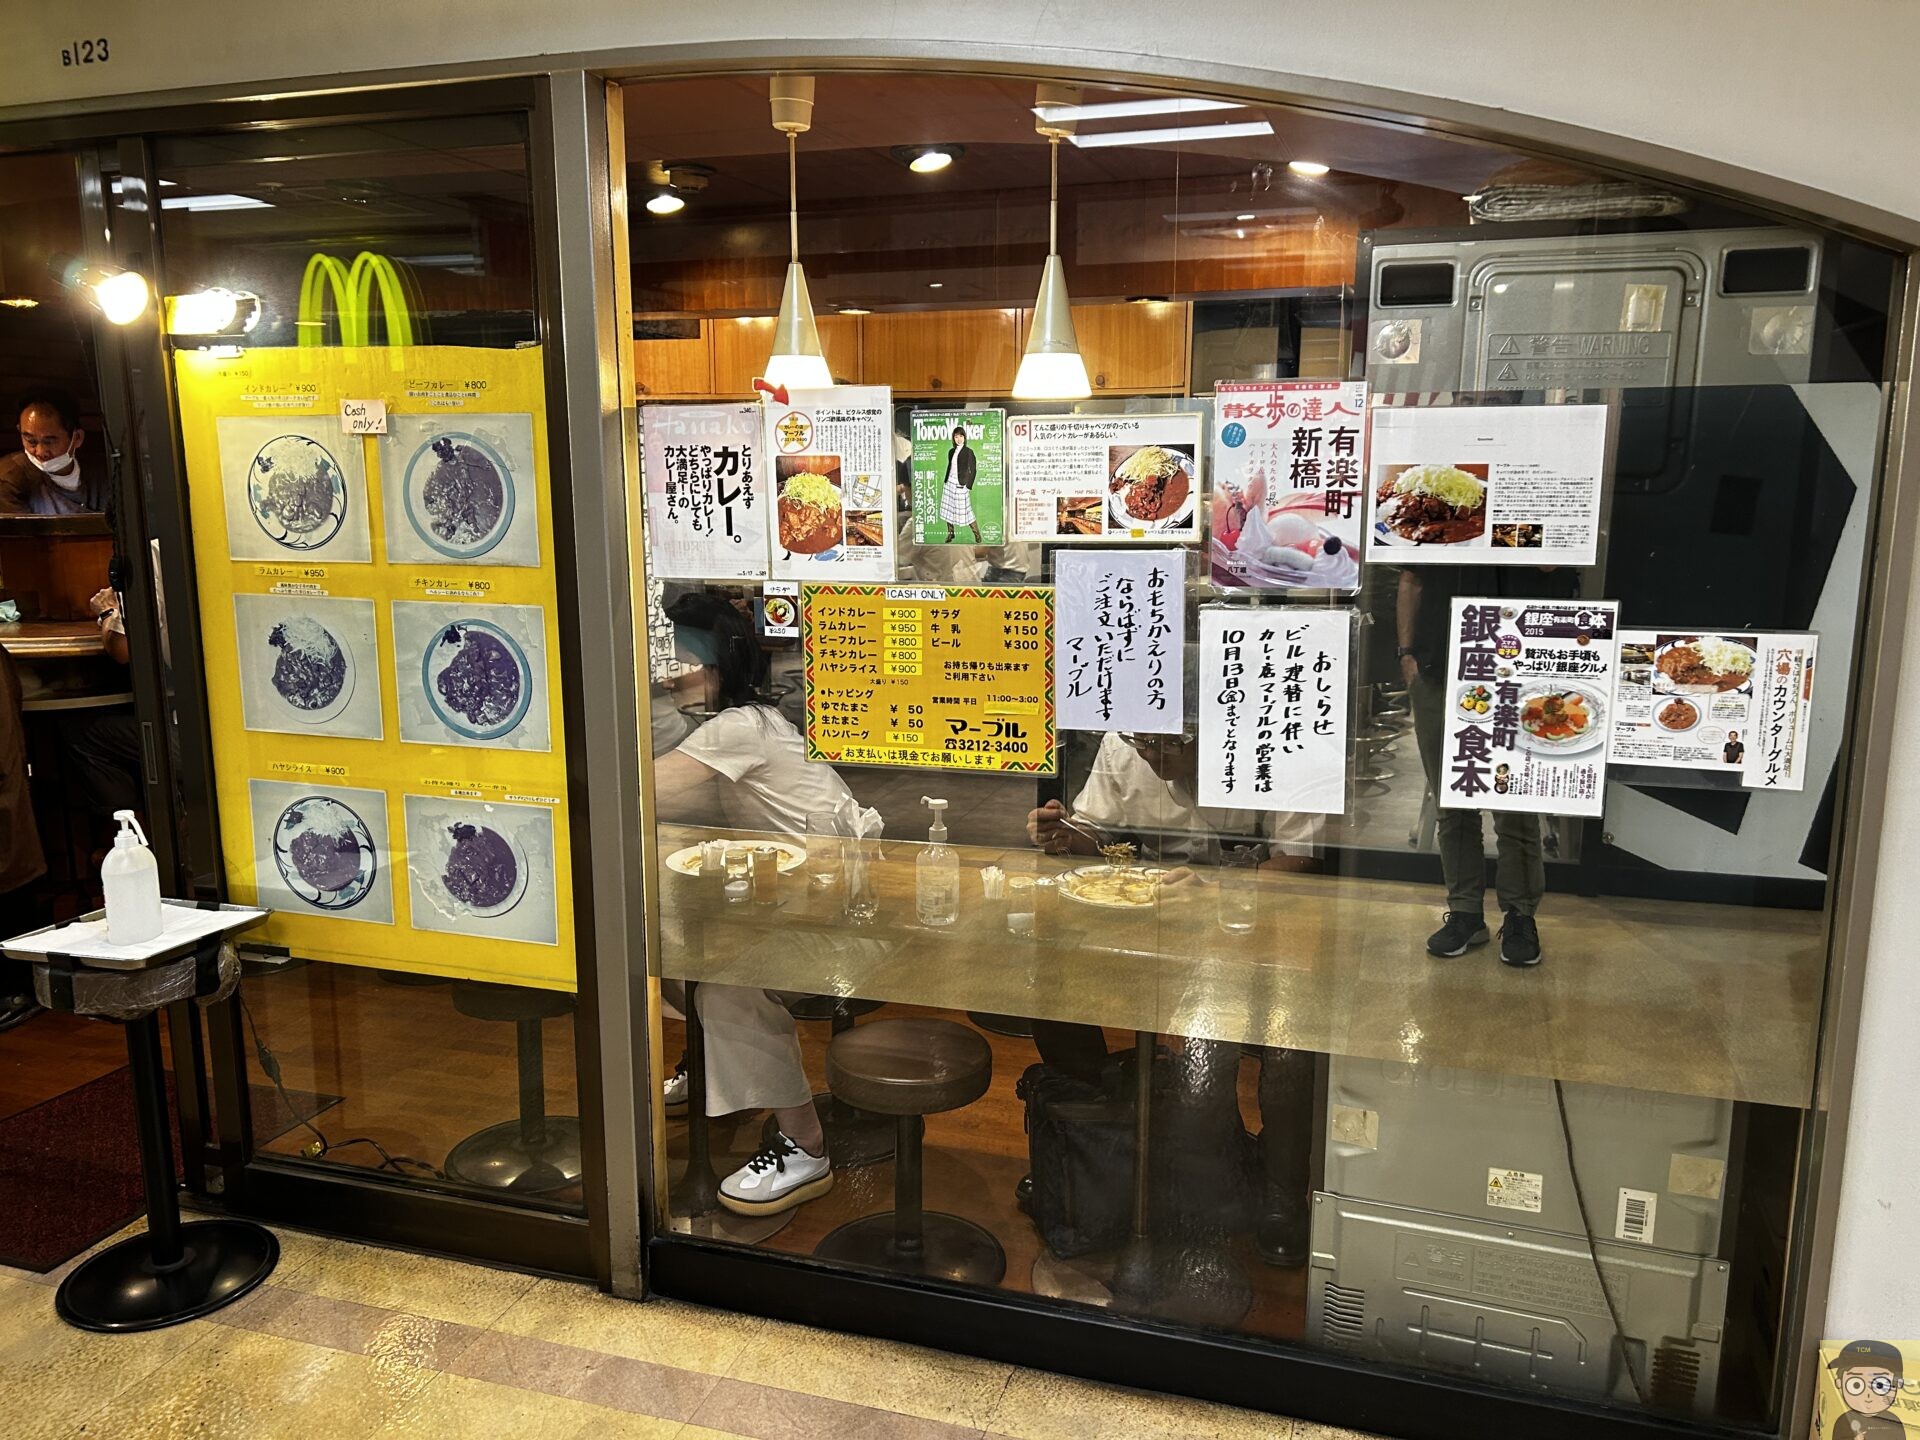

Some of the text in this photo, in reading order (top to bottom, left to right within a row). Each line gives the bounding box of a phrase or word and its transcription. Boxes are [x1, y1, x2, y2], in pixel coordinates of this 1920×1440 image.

[1578, 336, 1649, 355] WARNING
[409, 381, 487, 389] ビーフカレー ¥800
[344, 404, 366, 416] Cash
[1222, 391, 1360, 429] 散歩の達人
[1355, 399, 1364, 407] 12
[1014, 424, 1027, 436] 05
[1034, 422, 1140, 432] てんこ盛りの千切りキャベツがのっている
[1034, 431, 1118, 440] 人気のインドカレーがあるらしい。
[1290, 426, 1322, 489] 新橋
[676, 445, 689, 508] 大満足!の
[741, 444, 754, 509] とりあえず
[1325, 426, 1360, 519] 有楽町
[664, 445, 678, 524] カレー屋さん。
[689, 445, 702, 531] どちらにしても
[700, 445, 713, 537] やっぱりカレー!
[713, 446, 741, 543] カレー。
[926, 470, 935, 524] 新しい丸の内
[259, 567, 325, 578] ラムカレー ¥950
[415, 579, 491, 590] チキンカレー ¥800
[921, 591, 945, 599] ONLY
[818, 607, 917, 618] インドカレー ¥900
[930, 609, 1039, 621] サラダ ¥250
[818, 621, 917, 632] ラムカレー ¥950
[1116, 578, 1141, 662] ならばずに
[1004, 626, 1038, 635] ¥150
[819, 635, 917, 646] ビーフカレー ¥800
[931, 638, 1039, 650] ビール ¥300
[1147, 567, 1171, 710] おもちかえりの方
[1458, 604, 1502, 681] 銀座
[1094, 573, 1114, 721] ご注文いただけます
[820, 649, 917, 660] チキンカレー ¥800
[1525, 648, 1600, 662] 贅沢もお手頃も
[820, 663, 917, 674] ハヤシライス ¥900
[944, 661, 1029, 672] お持ち帰りも出来ます
[1066, 637, 1092, 698] マーブル
[1513, 660, 1608, 674] やっぱり!銀座グルメ
[944, 672, 995, 682] ご利用下さい
[1280, 624, 1310, 753] ビル建替に伴い
[1313, 651, 1337, 735] おしらせ
[821, 702, 868, 713] ゆでたまご
[932, 696, 960, 704] 営業時間
[963, 697, 977, 705] 平日
[1254, 629, 1278, 792] カレー店マーブルの営業は
[1491, 680, 1522, 751] 有楽町
[1765, 648, 1792, 786] 穴場のカウンターグルメ
[821, 715, 859, 726] 生たまご
[944, 718, 1027, 738] マーブル
[822, 730, 919, 742] ハンバーグ ¥150
[845, 748, 995, 766] お支払いは現金でお願いします
[1451, 724, 1493, 798] 食本
[272, 763, 346, 775] ハヤシライス ¥900
